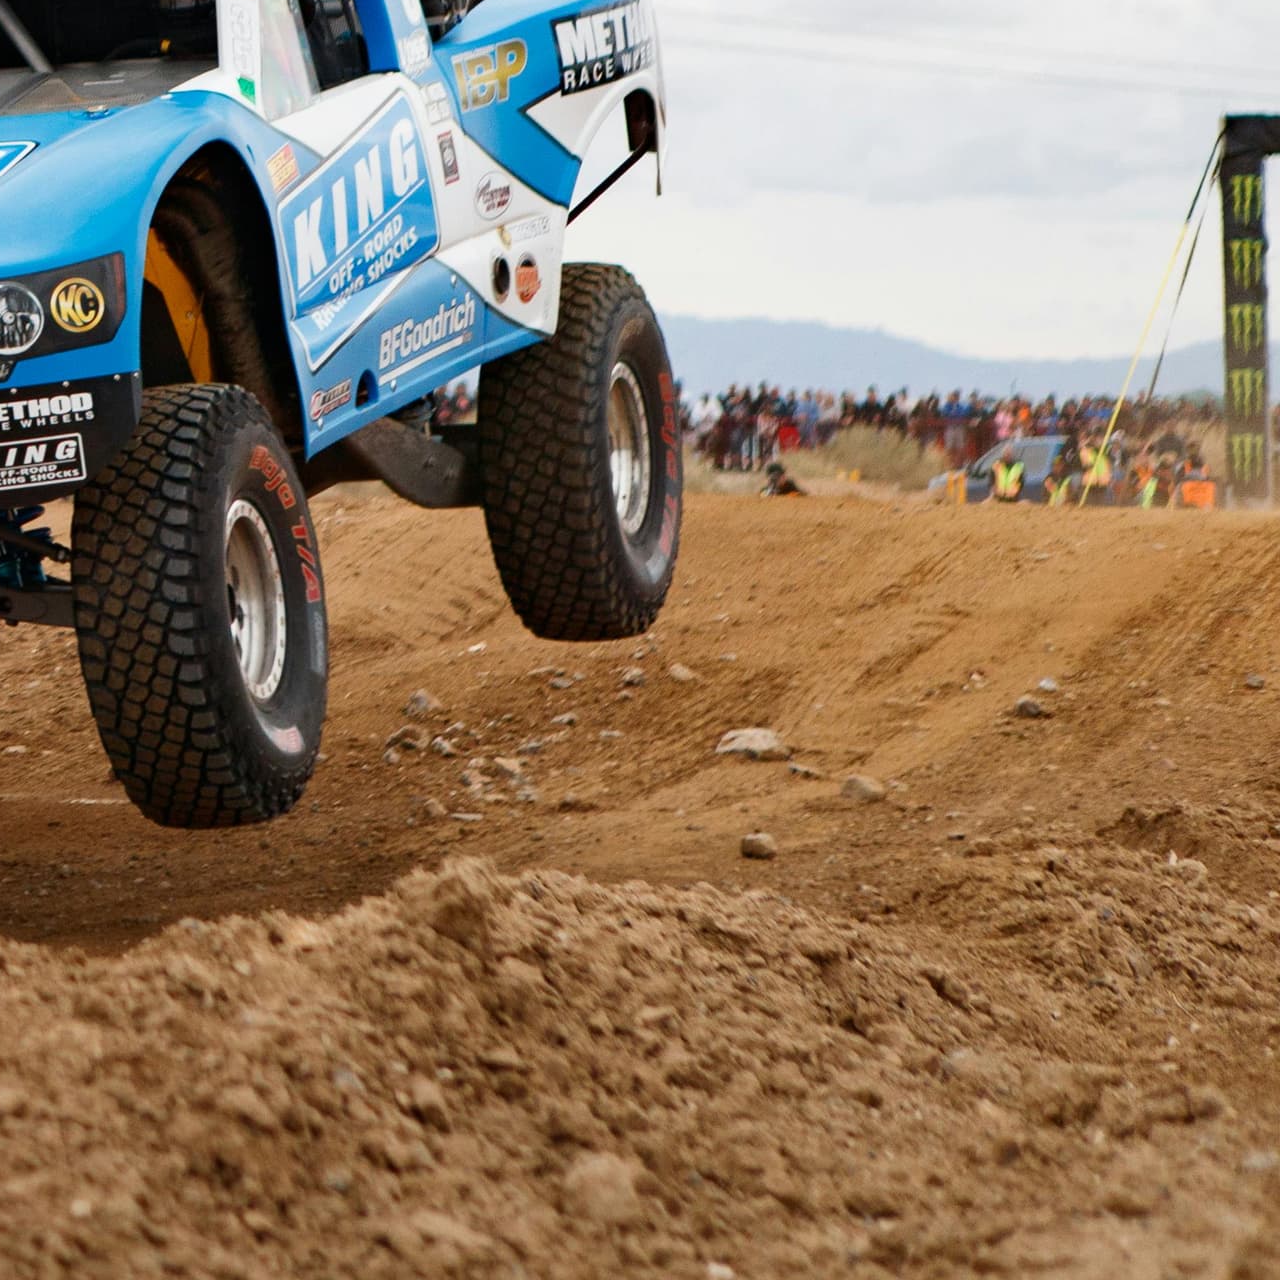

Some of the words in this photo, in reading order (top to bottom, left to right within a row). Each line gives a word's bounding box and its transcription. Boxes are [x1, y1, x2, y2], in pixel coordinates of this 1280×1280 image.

[563, 56, 615, 90] RACE
[293, 117, 420, 291] KING
[367, 225, 419, 283] SHOCKS
[57, 288, 98, 328] KC
[378, 290, 476, 370] BFGoodrich
[20, 411, 95, 428] WHEELS
[30, 469, 80, 482] SHOCKS
[249, 445, 297, 510] Baja
[291, 515, 322, 603] T/A
